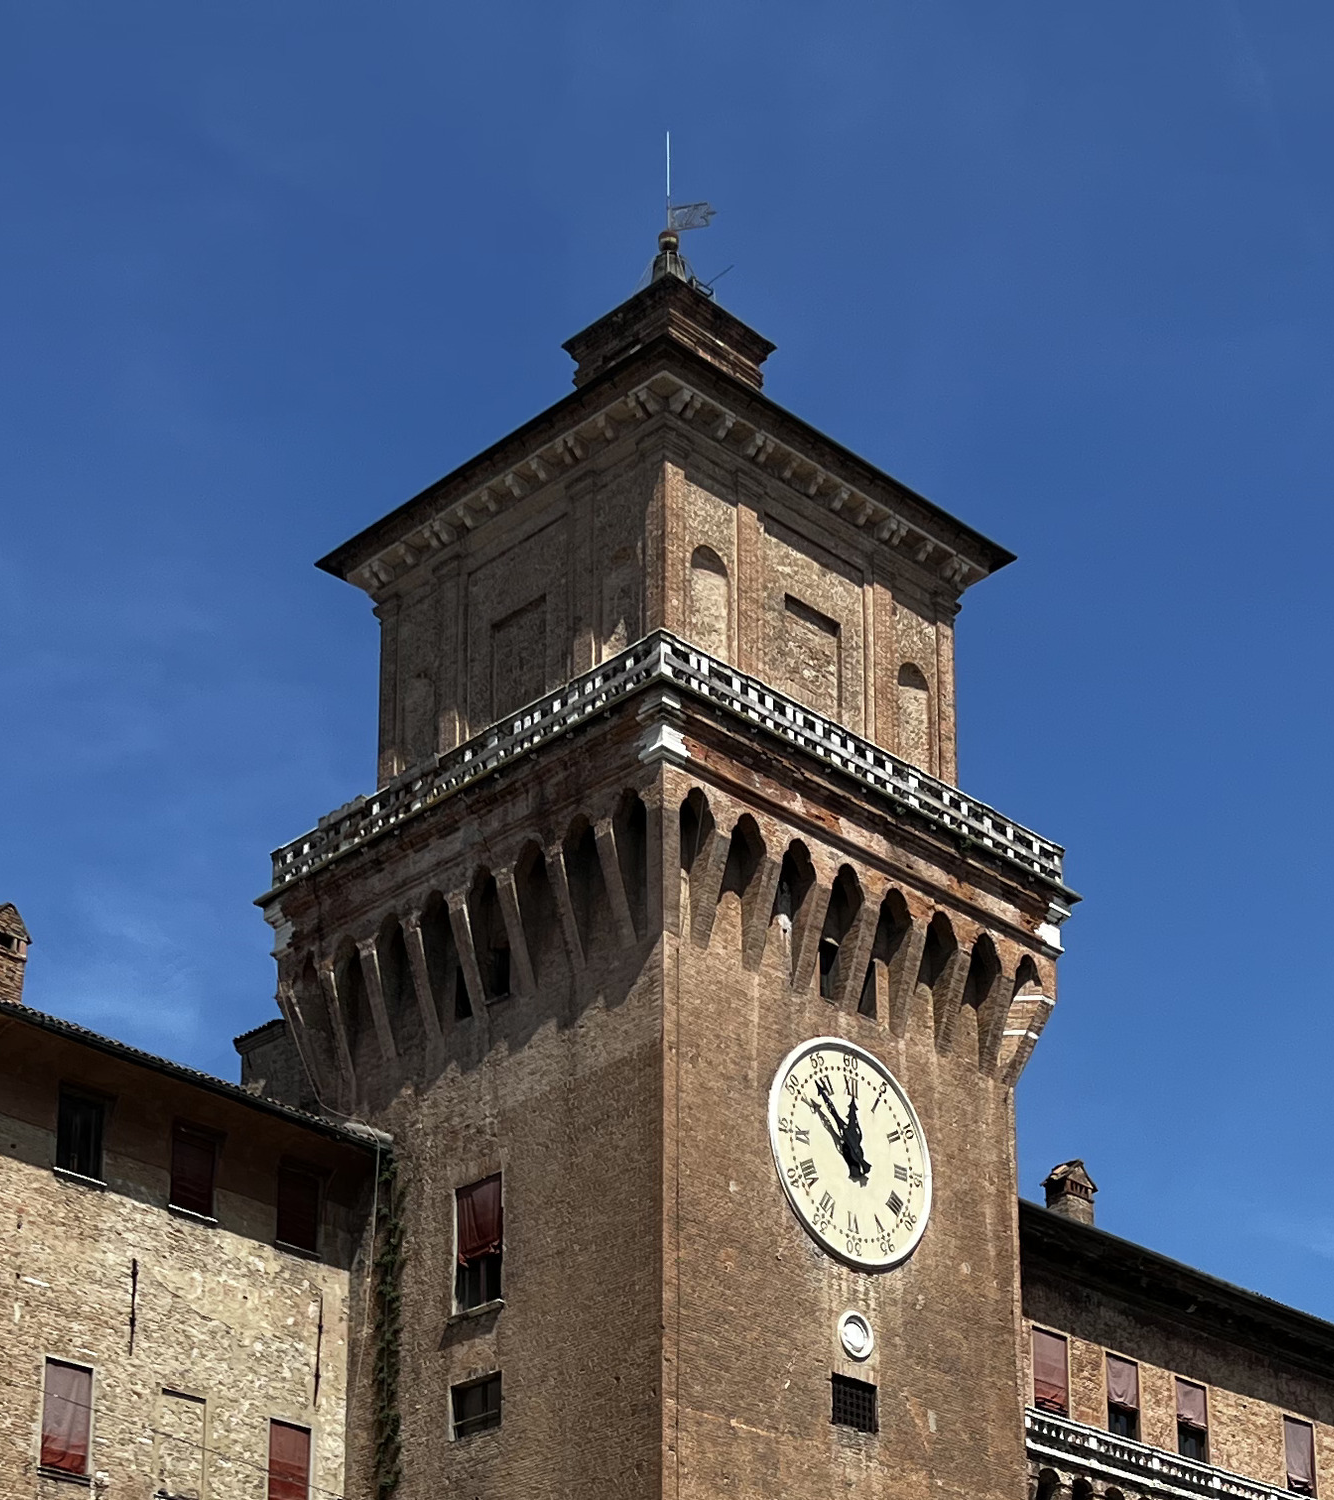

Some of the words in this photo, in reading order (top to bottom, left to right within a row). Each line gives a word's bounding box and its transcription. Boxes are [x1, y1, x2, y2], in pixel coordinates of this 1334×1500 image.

[810, 1052, 824, 1069] 55
[843, 1053, 858, 1070] 60
[785, 1074, 799, 1095] 50
[887, 1130, 900, 1144] II
[903, 1123, 914, 1139] 10
[787, 1168, 799, 1188] 40
[800, 1158, 819, 1189] VIII
[893, 1163, 907, 1182] III
[913, 1172, 923, 1188] 15
[819, 1190, 835, 1219] VII
[812, 1213, 828, 1235] 35
[902, 1210, 917, 1231] 20
[846, 1240, 862, 1257] 30
[880, 1238, 895, 1256] 25
